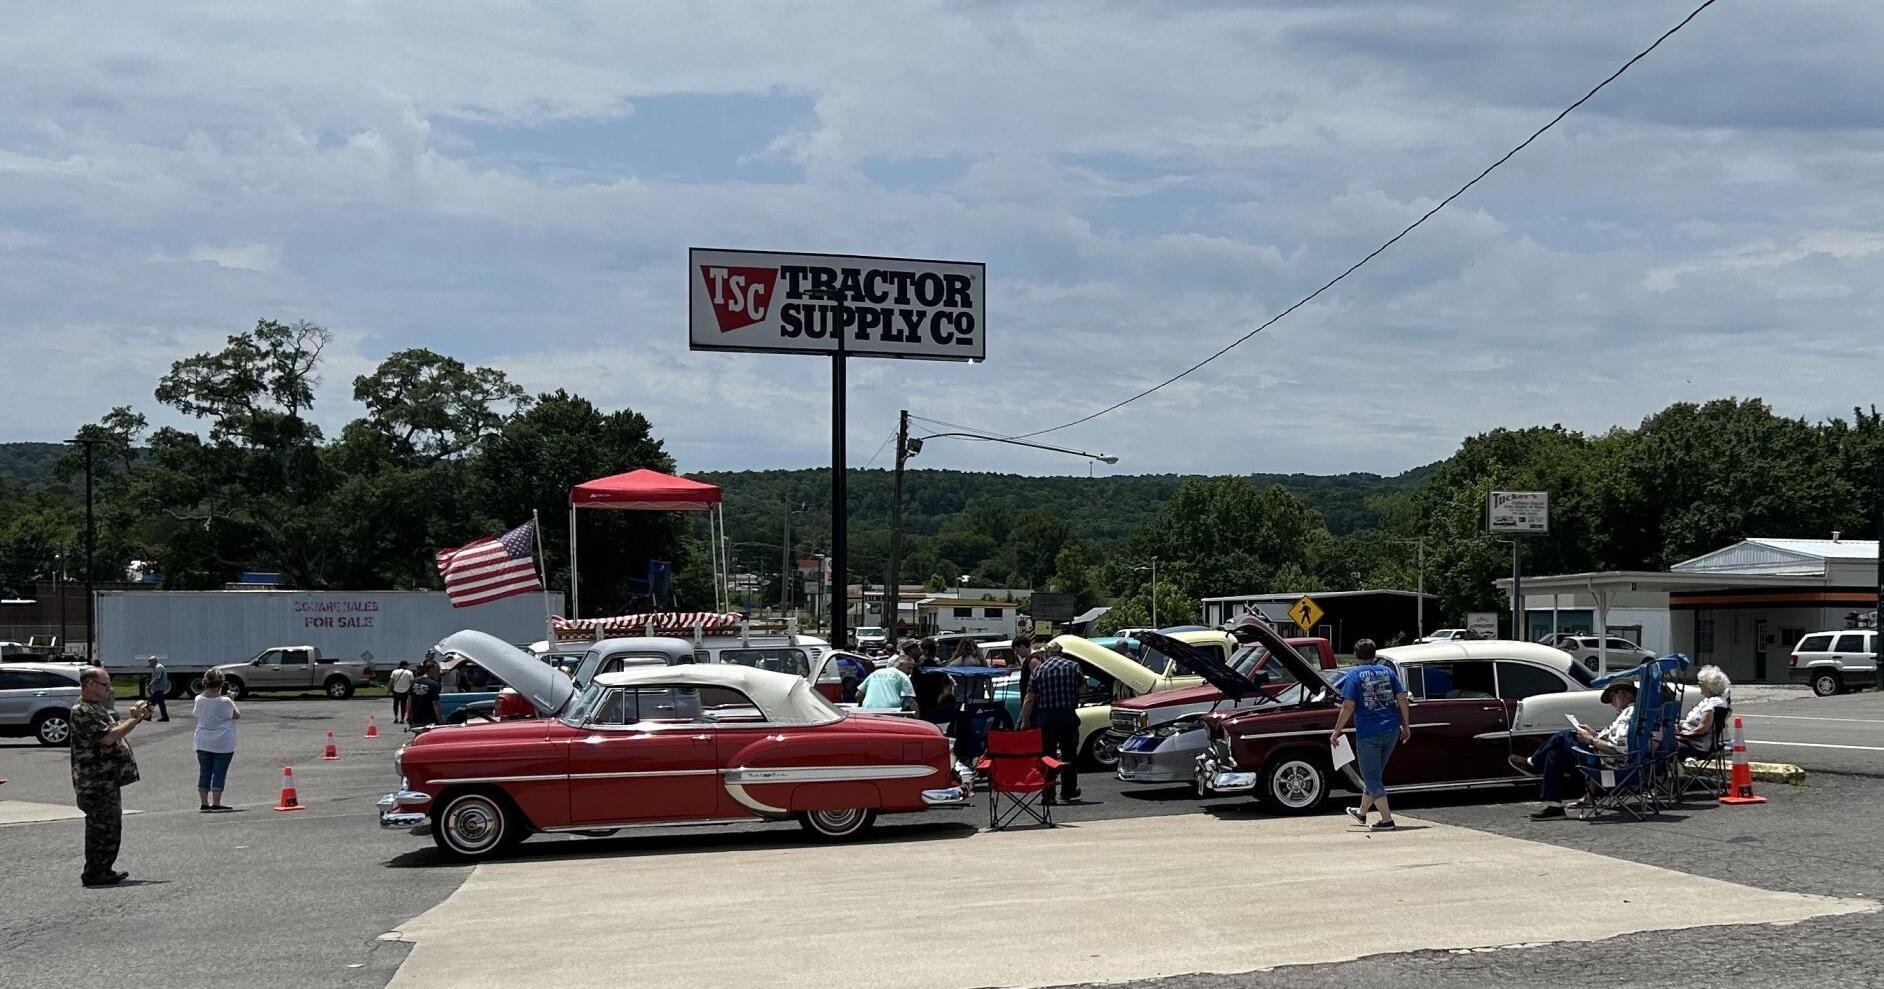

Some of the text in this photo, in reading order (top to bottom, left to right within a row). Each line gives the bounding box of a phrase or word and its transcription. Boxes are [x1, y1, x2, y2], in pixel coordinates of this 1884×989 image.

[709, 267, 765, 321] TSC
[780, 265, 974, 309] TRACTOR
[780, 303, 927, 343] SUPPLY
[304, 616, 374, 629] FOR SALE
